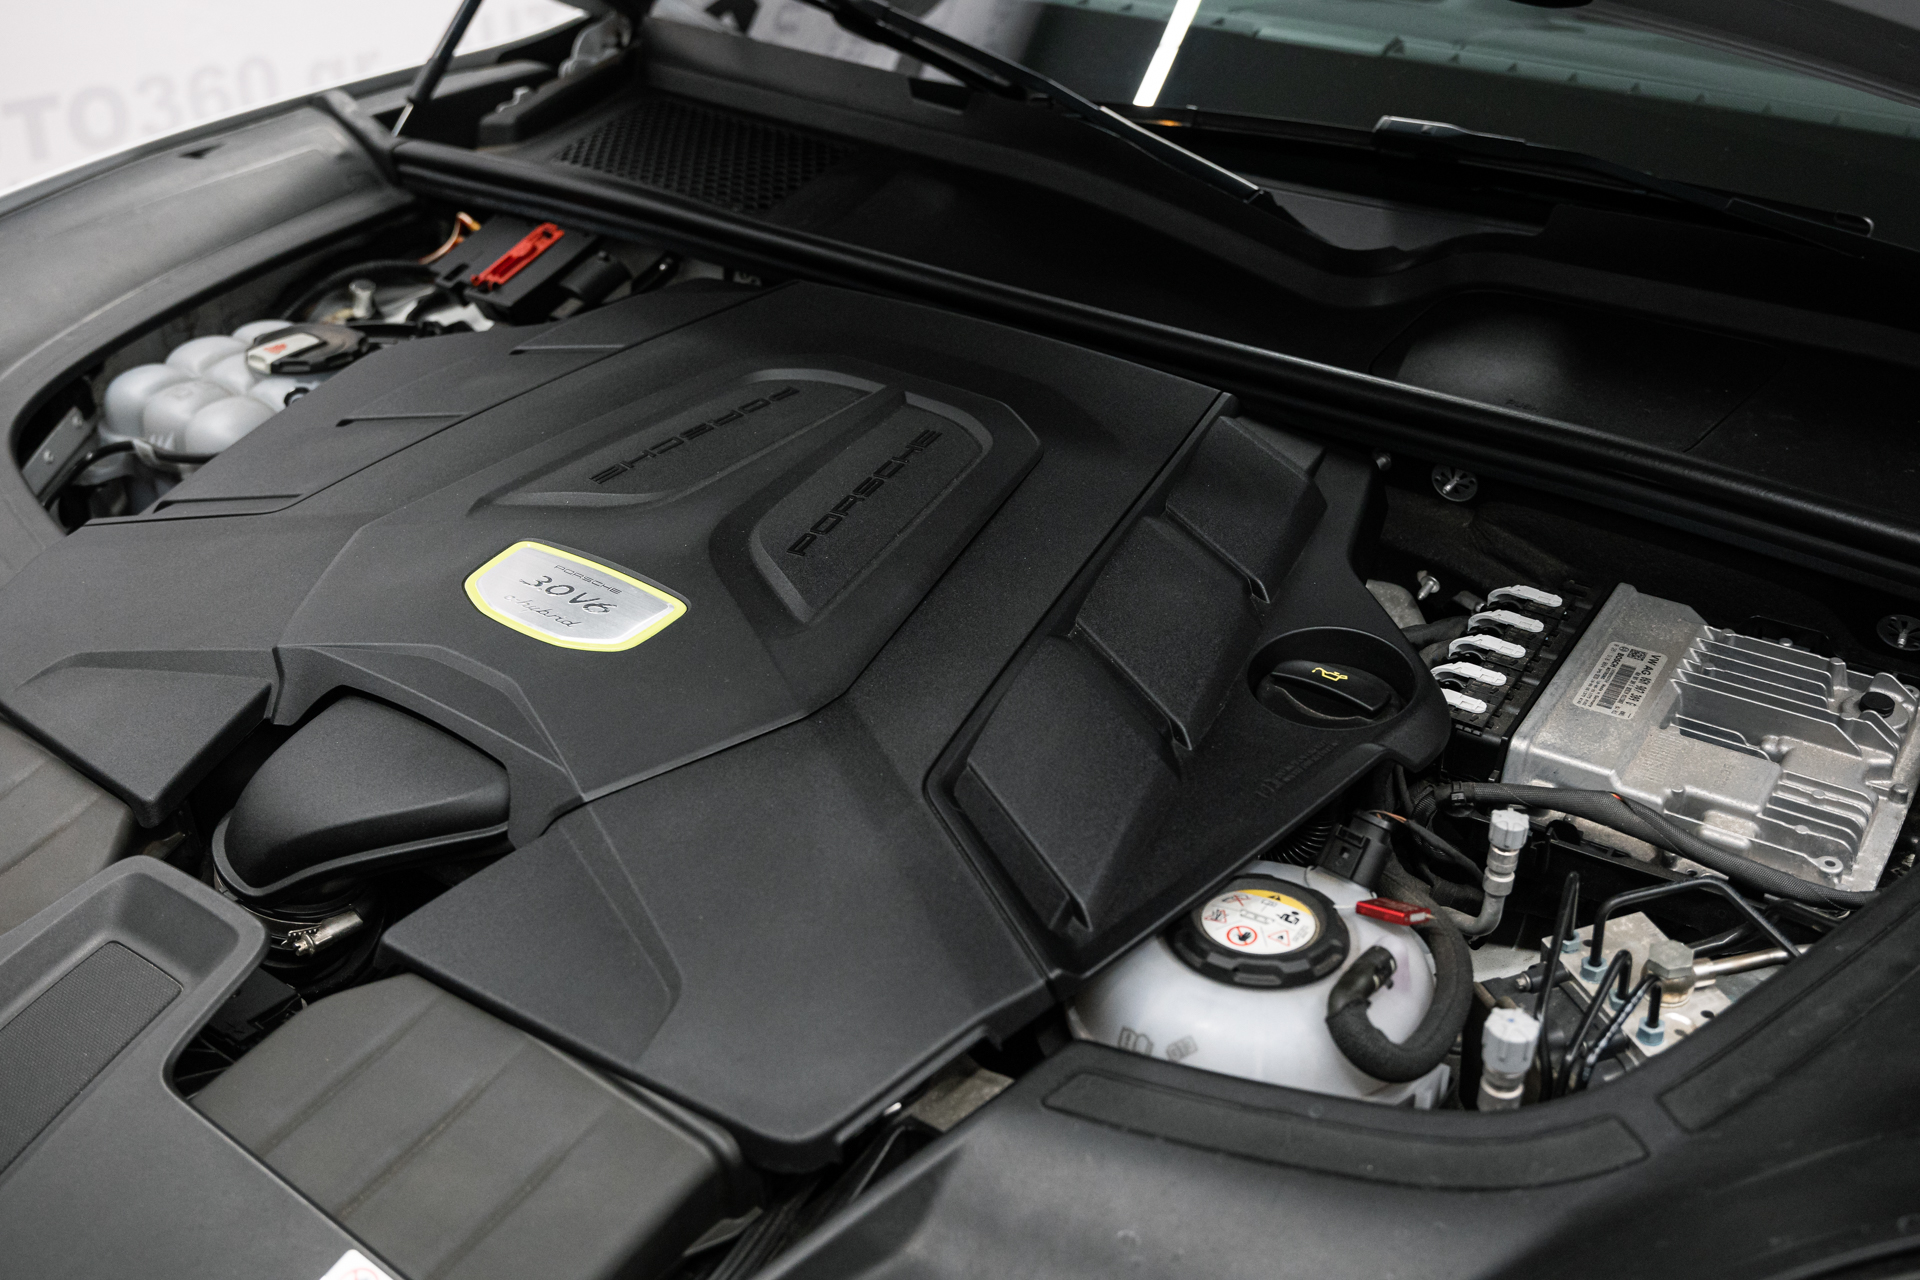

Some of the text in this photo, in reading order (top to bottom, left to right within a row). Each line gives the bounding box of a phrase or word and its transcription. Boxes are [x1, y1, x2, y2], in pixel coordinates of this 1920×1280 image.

[588, 386, 800, 486] PORSCHE
[786, 428, 943, 557] PORSCHE
[553, 564, 623, 595] PORSCHE
[1609, 652, 1625, 668] BOSCH
[1641, 665, 1654, 676] AG
[1647, 654, 1662, 667] VW
